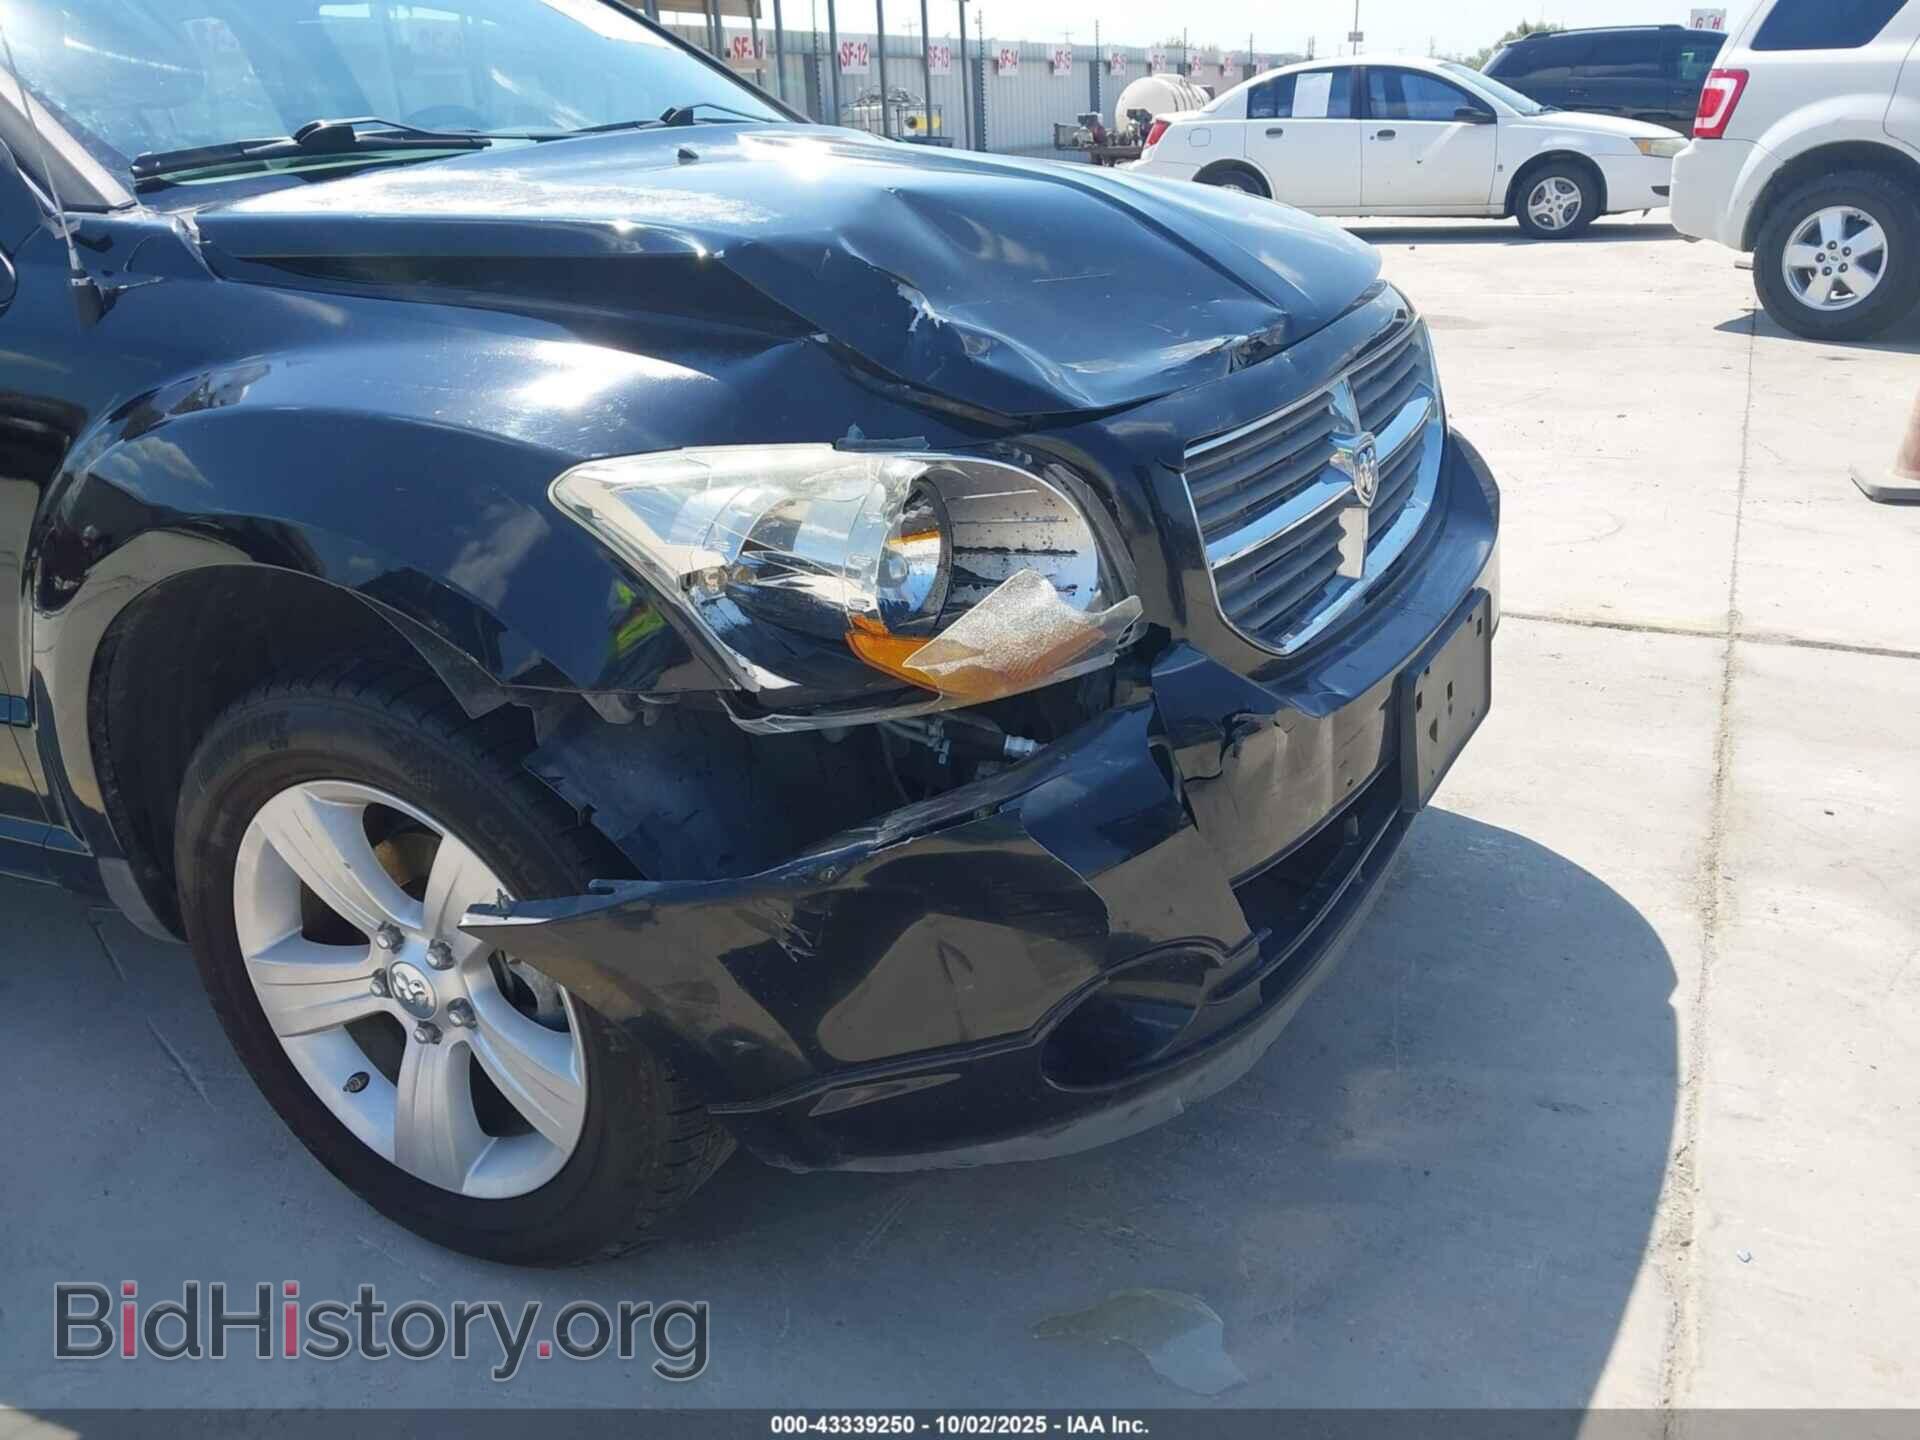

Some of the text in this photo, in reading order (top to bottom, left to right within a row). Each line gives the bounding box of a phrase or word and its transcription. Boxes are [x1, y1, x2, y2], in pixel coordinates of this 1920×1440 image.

[1711, 16, 1721, 30] H
[733, 36, 764, 59] SF-1
[841, 41, 868, 67] SF-12
